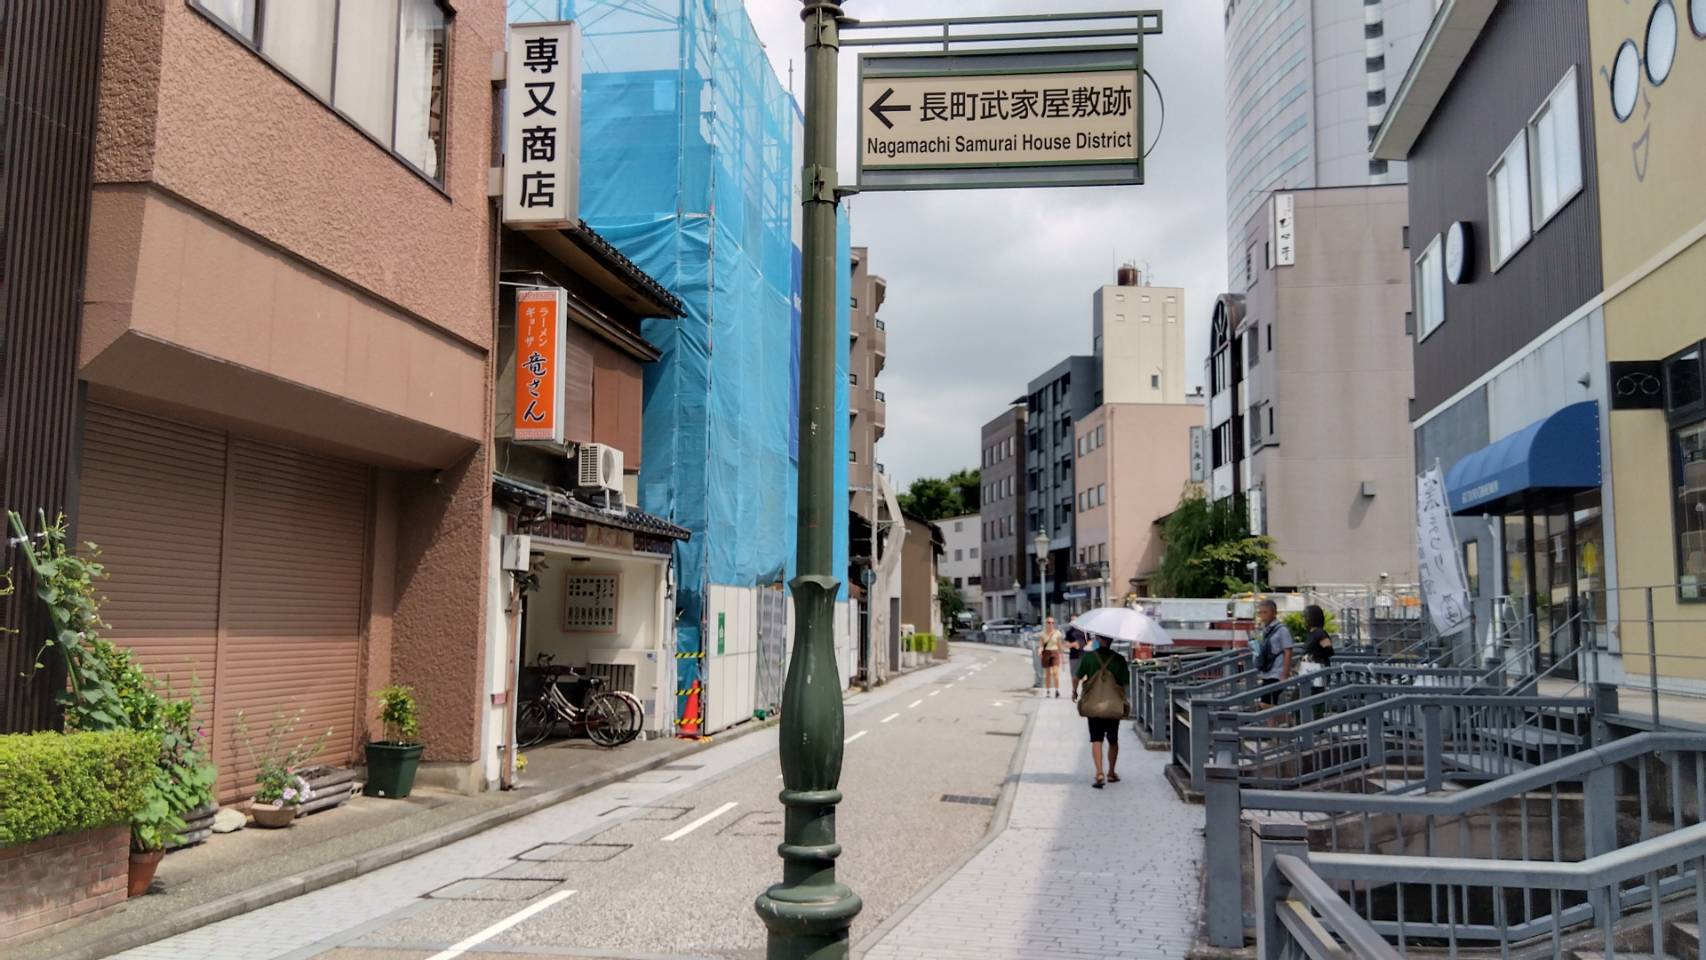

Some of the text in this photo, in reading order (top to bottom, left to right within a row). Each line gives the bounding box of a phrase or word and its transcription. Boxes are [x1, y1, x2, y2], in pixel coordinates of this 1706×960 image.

[520, 37, 559, 208] 専又商店
[920, 85, 1132, 122] 長町武家屋敷跡
[867, 131, 1132, 158] Nagamachi Samurai House District
[525, 306, 536, 348] ギョーザ
[539, 306, 549, 348] ラーメン
[522, 351, 547, 422] 竜さん
